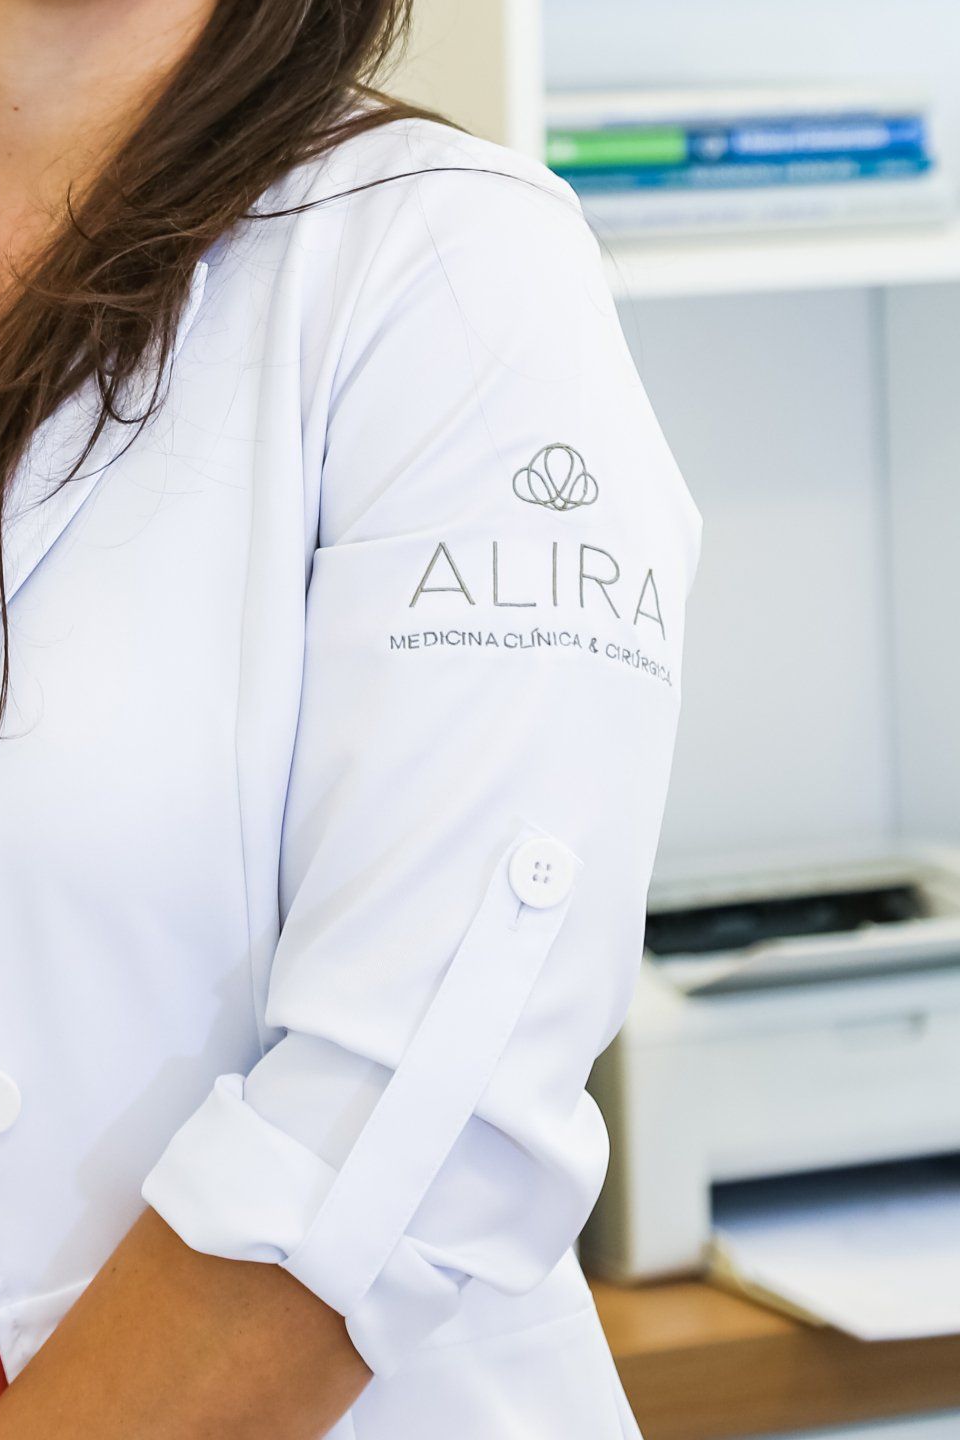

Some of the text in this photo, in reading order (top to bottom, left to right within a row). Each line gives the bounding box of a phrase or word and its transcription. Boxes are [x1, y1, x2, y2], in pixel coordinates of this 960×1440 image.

[409, 541, 666, 640] ALIRA
[390, 627, 672, 687] MEDICINA CLÍNICA & CIRÚRGICA
